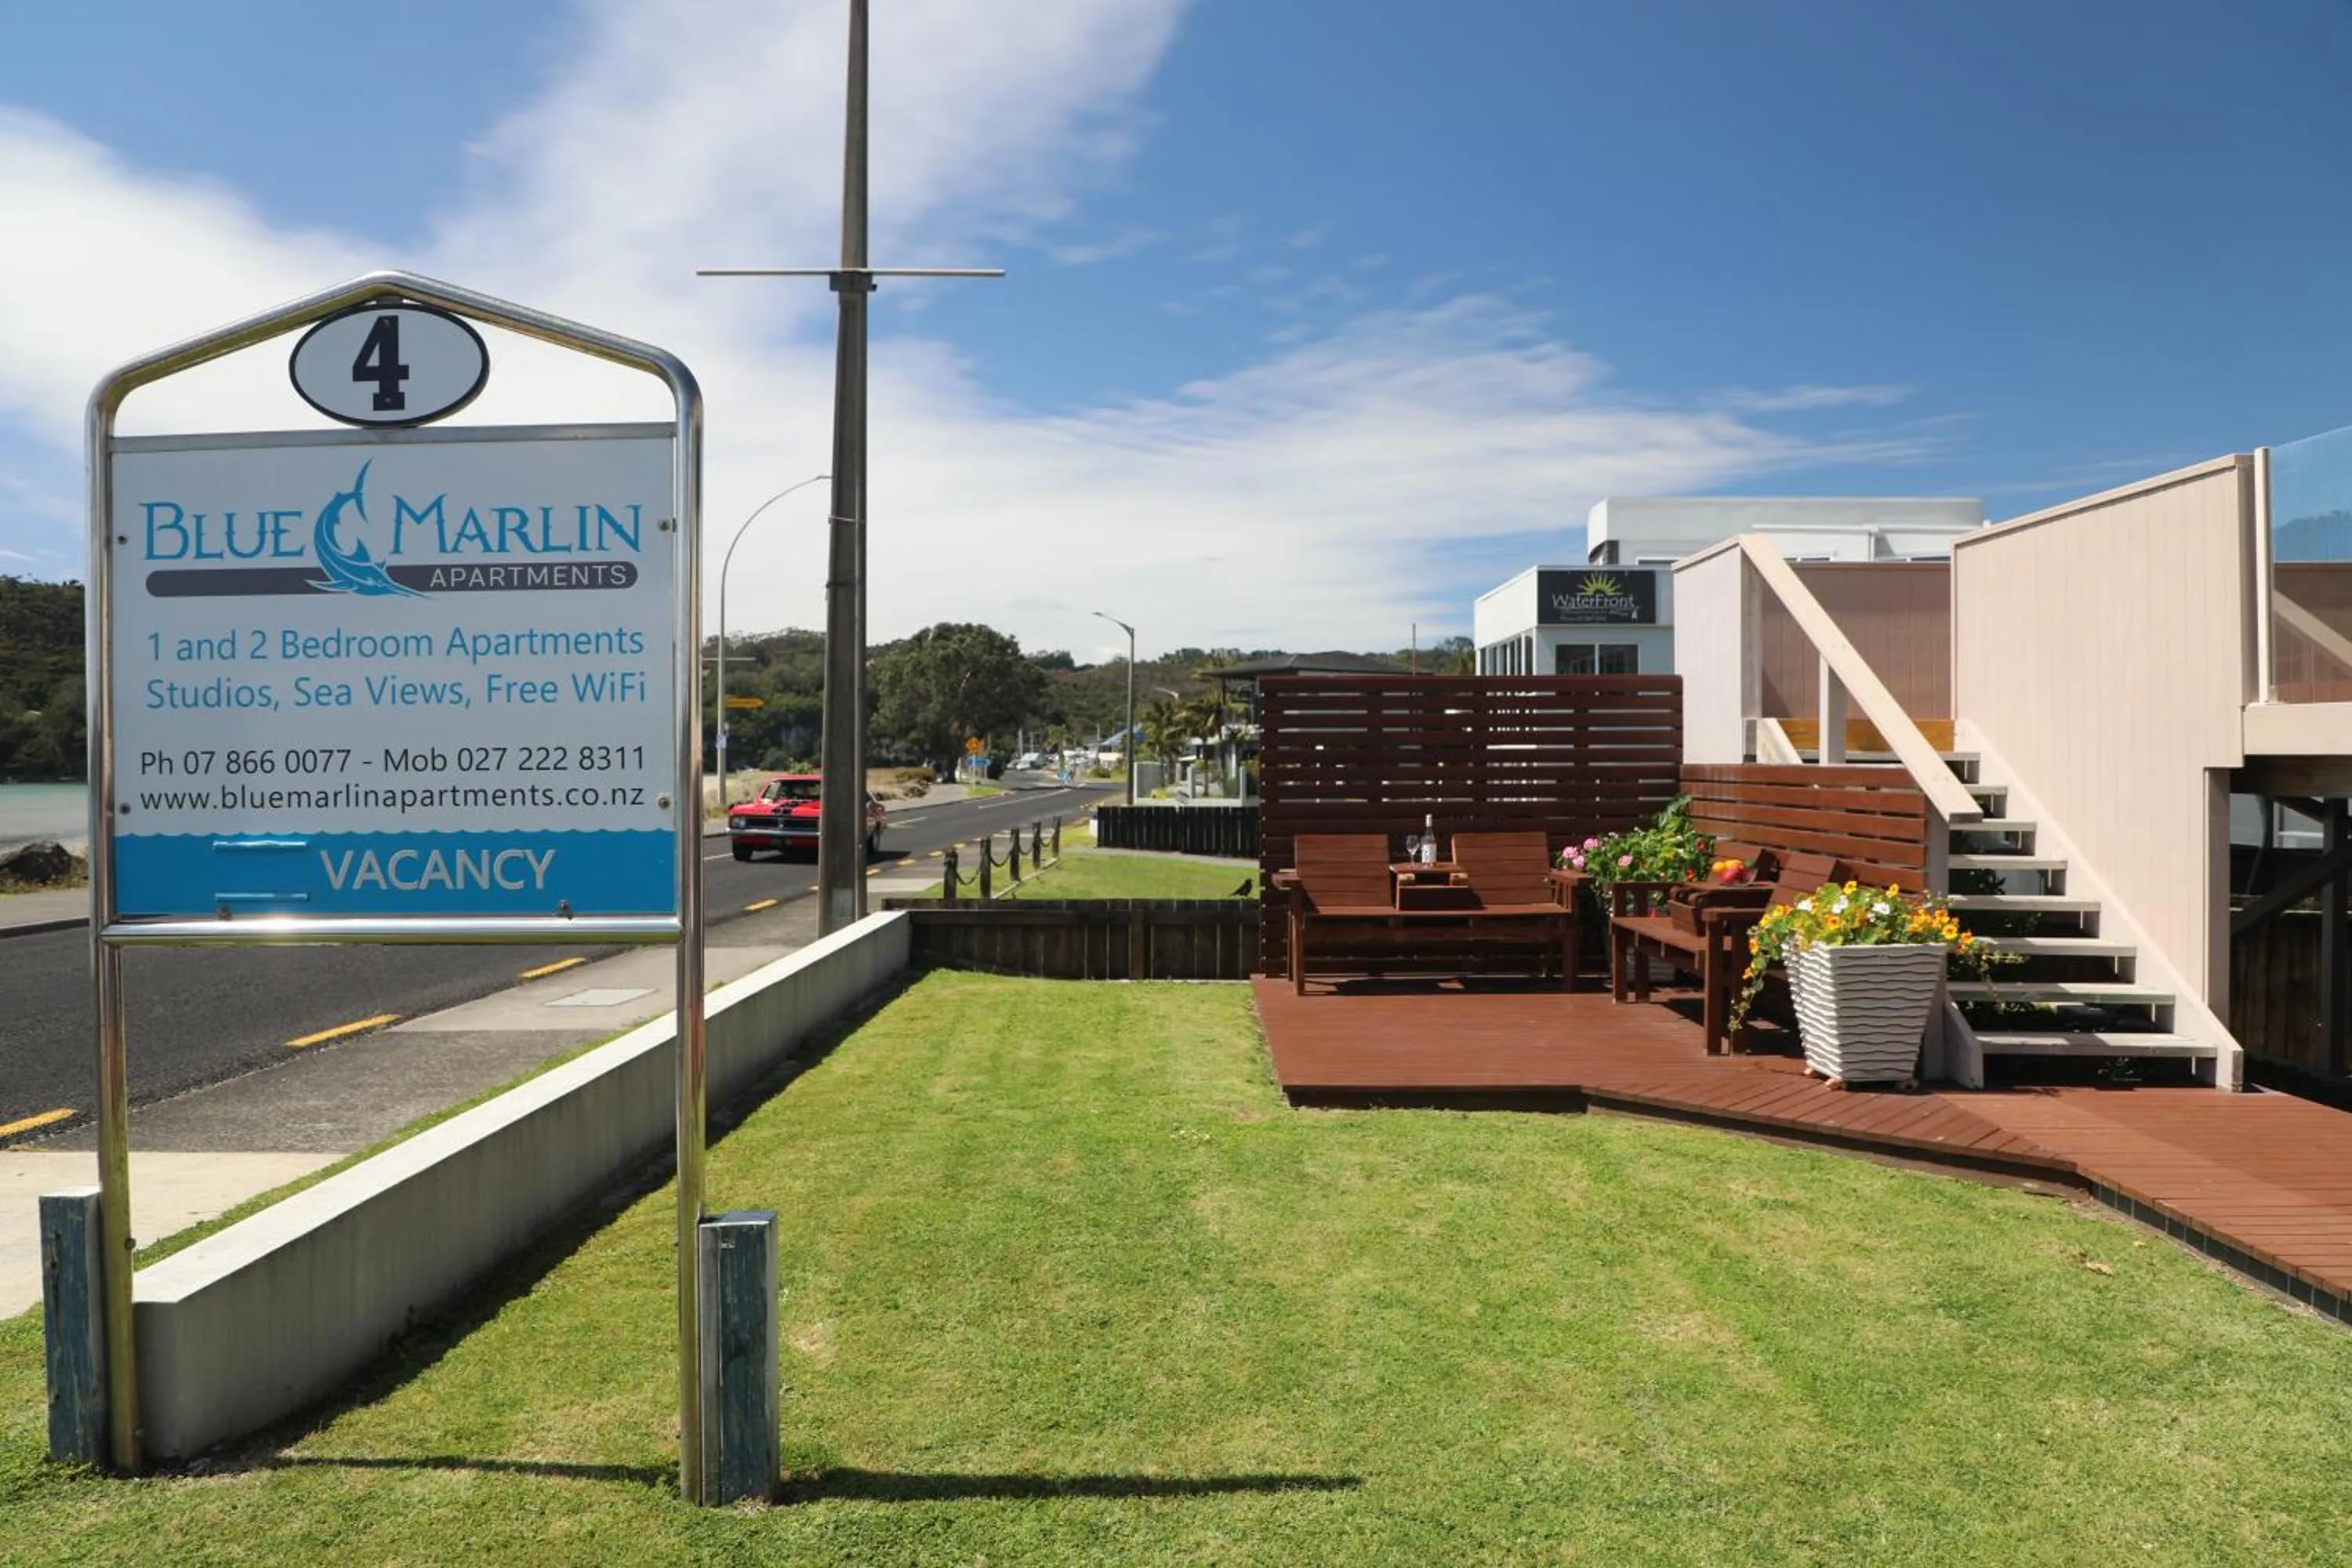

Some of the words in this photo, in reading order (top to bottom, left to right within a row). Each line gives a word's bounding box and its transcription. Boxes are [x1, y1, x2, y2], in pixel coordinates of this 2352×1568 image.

[352, 314, 409, 411] 4
[139, 502, 305, 561] BLUE
[392, 493, 641, 554] MARLIN
[430, 564, 627, 588] APARTMENTS
[148, 632, 159, 660] 1
[176, 629, 236, 660] and
[250, 630, 267, 659] 2
[281, 627, 433, 659] Bedroom
[445, 626, 644, 665] Apartments
[147, 677, 279, 712] Studios,
[293, 676, 352, 706] Sea
[365, 674, 470, 710] Views,
[486, 673, 559, 704] Free
[572, 671, 646, 703] WiFi
[141, 750, 173, 775] Ph
[183, 750, 216, 775] 07
[226, 750, 275, 774] 866
[285, 749, 351, 773] 0077
[383, 747, 448, 772] Mob
[457, 746, 508, 771] 027
[517, 746, 568, 771] 222
[579, 746, 644, 771] 8311
[140, 783, 644, 814] www.bluemarlinapartments.co.nz
[319, 849, 557, 890] VACANCY
